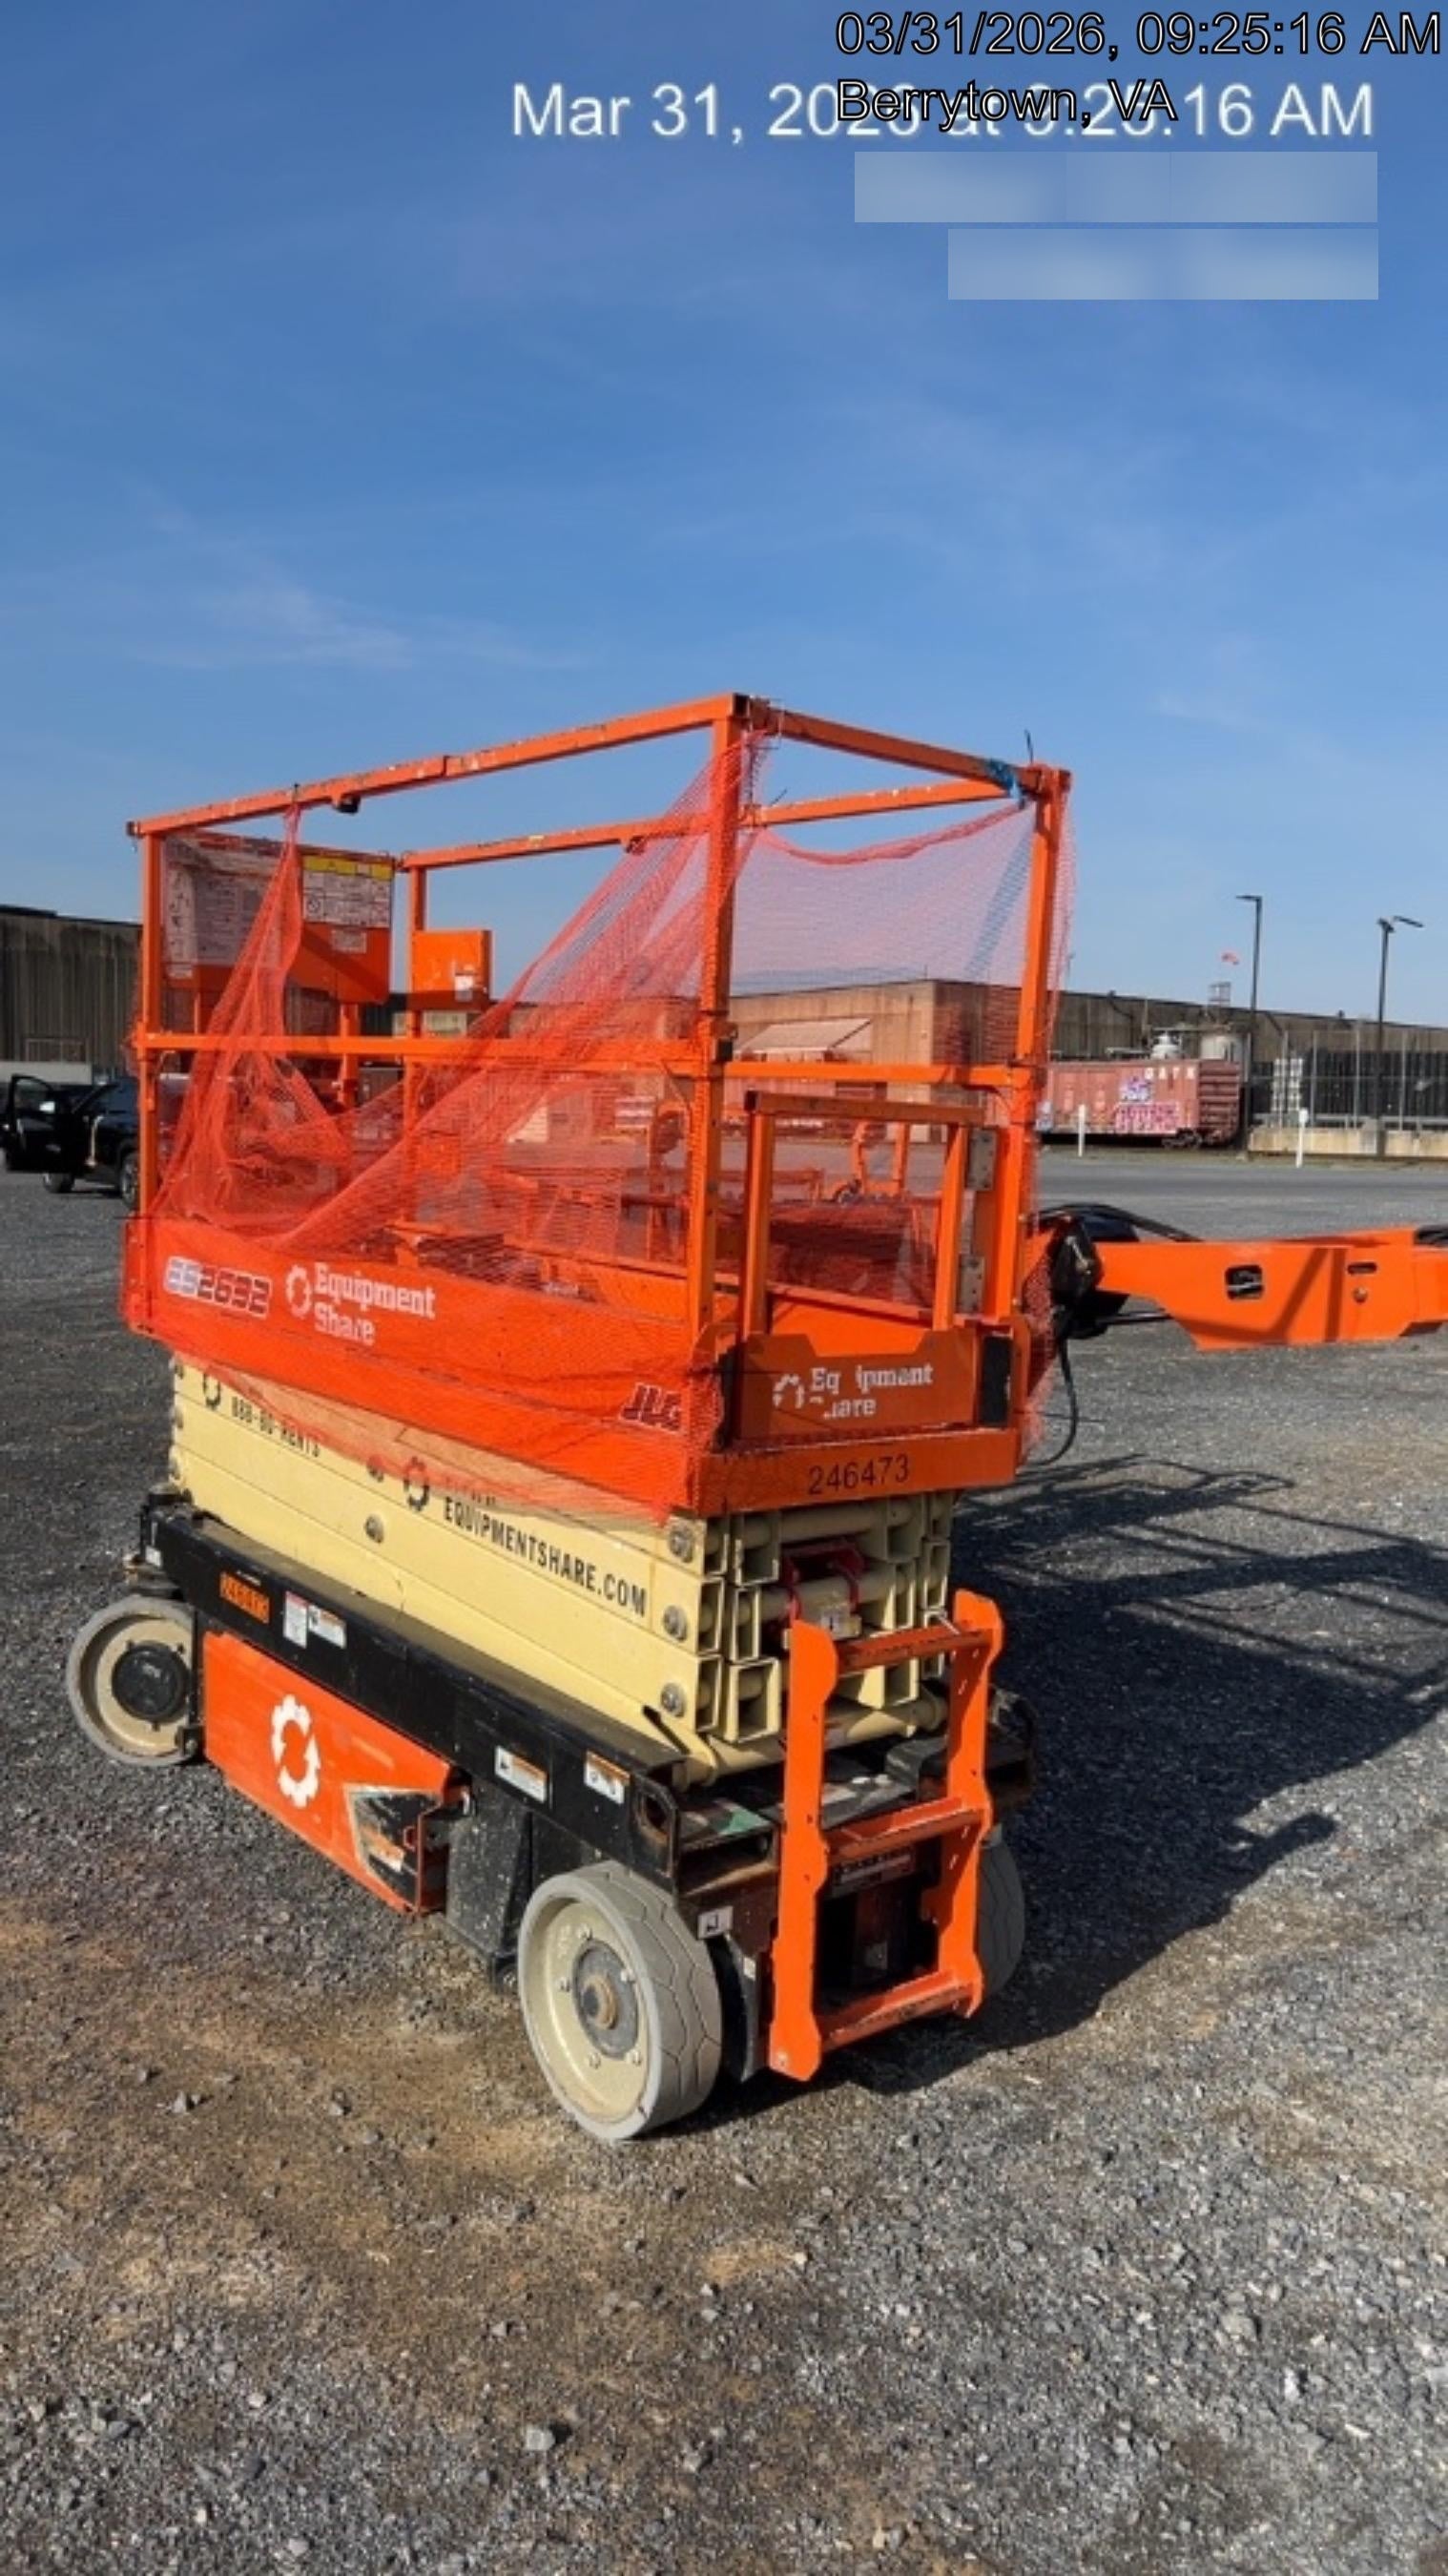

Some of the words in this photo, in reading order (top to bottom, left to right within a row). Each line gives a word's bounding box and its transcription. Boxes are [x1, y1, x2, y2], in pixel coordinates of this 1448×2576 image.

[314, 1261, 436, 1319] Equipment
[314, 1302, 376, 1346] Share
[808, 1452, 911, 1496] 246473
[444, 1495, 648, 1618] EQUIPMENTSHARE.COM
